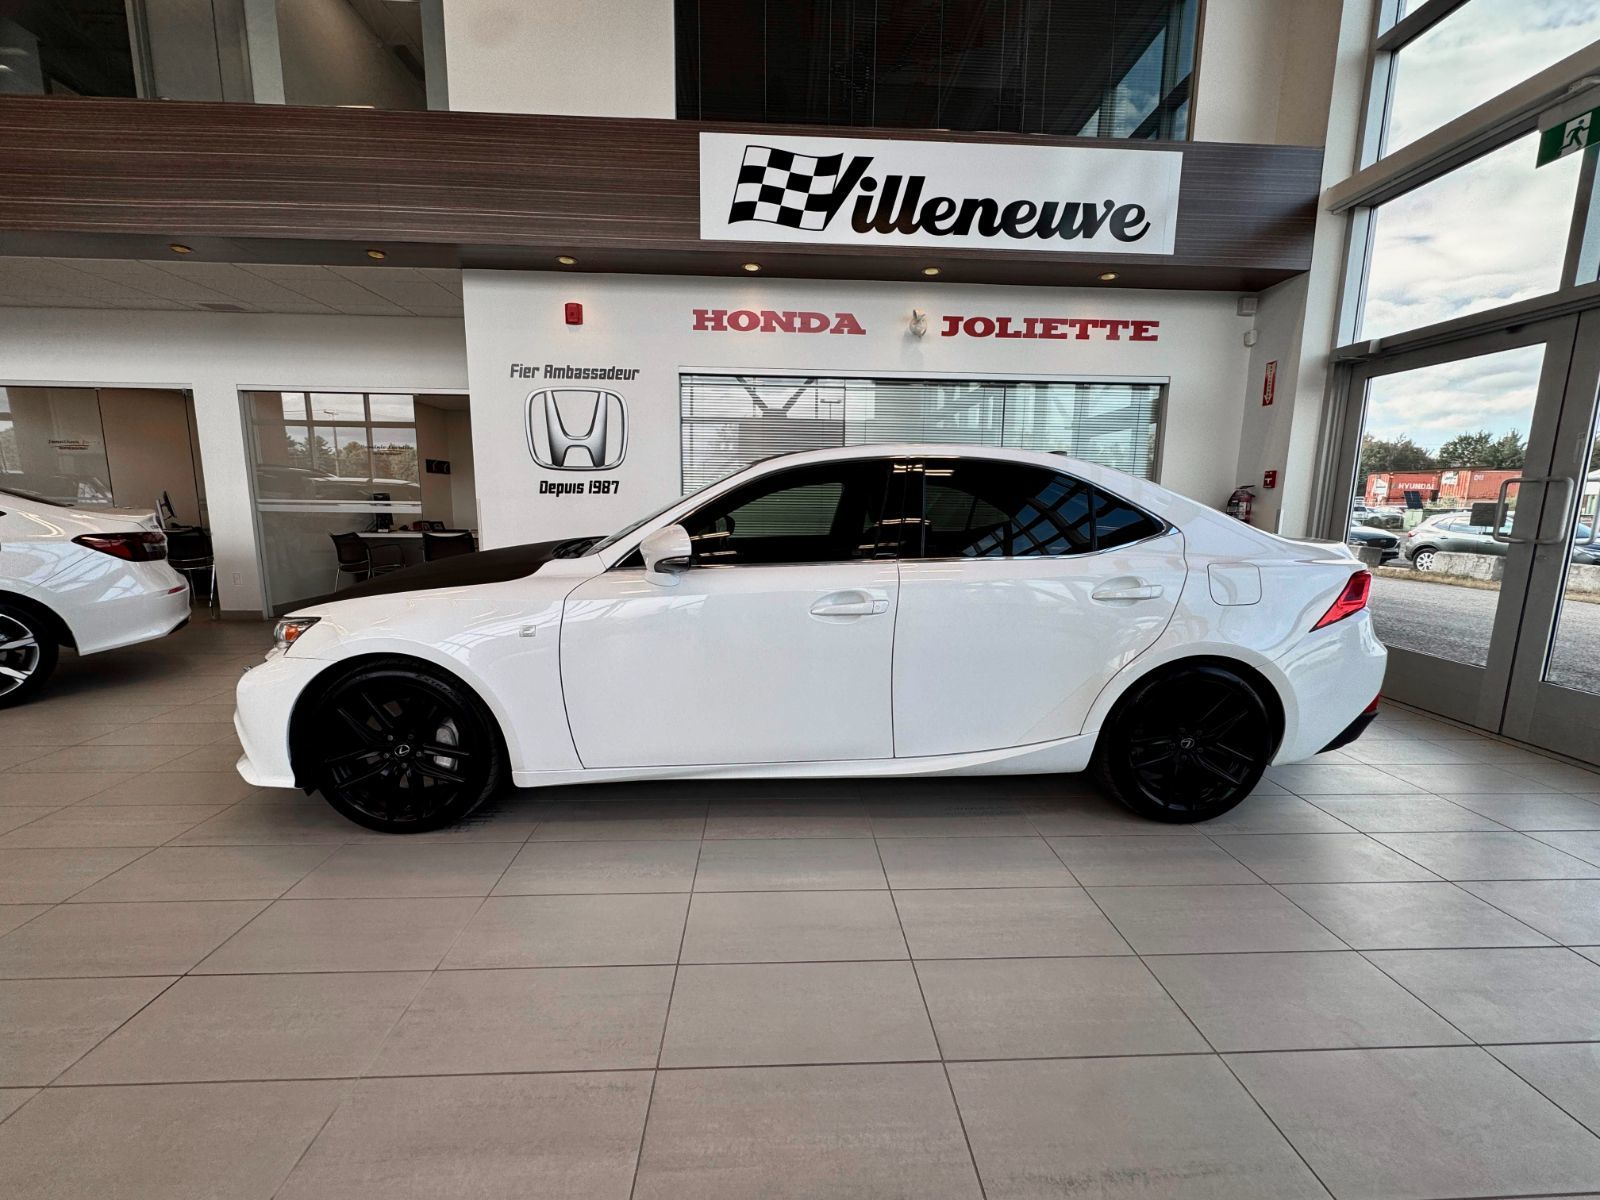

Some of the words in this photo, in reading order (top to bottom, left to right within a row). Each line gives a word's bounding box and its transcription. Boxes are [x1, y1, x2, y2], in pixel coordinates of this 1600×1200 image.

[822, 156, 1152, 243] Villeneuve
[692, 309, 867, 336] HONDA
[941, 315, 1160, 342] JOLIETTE
[510, 363, 540, 379] Fier
[543, 364, 640, 381] Ambassadeur
[539, 480, 585, 497] Depuis
[588, 480, 620, 494] 1987
[1398, 482, 1435, 490] HYUNDAI
